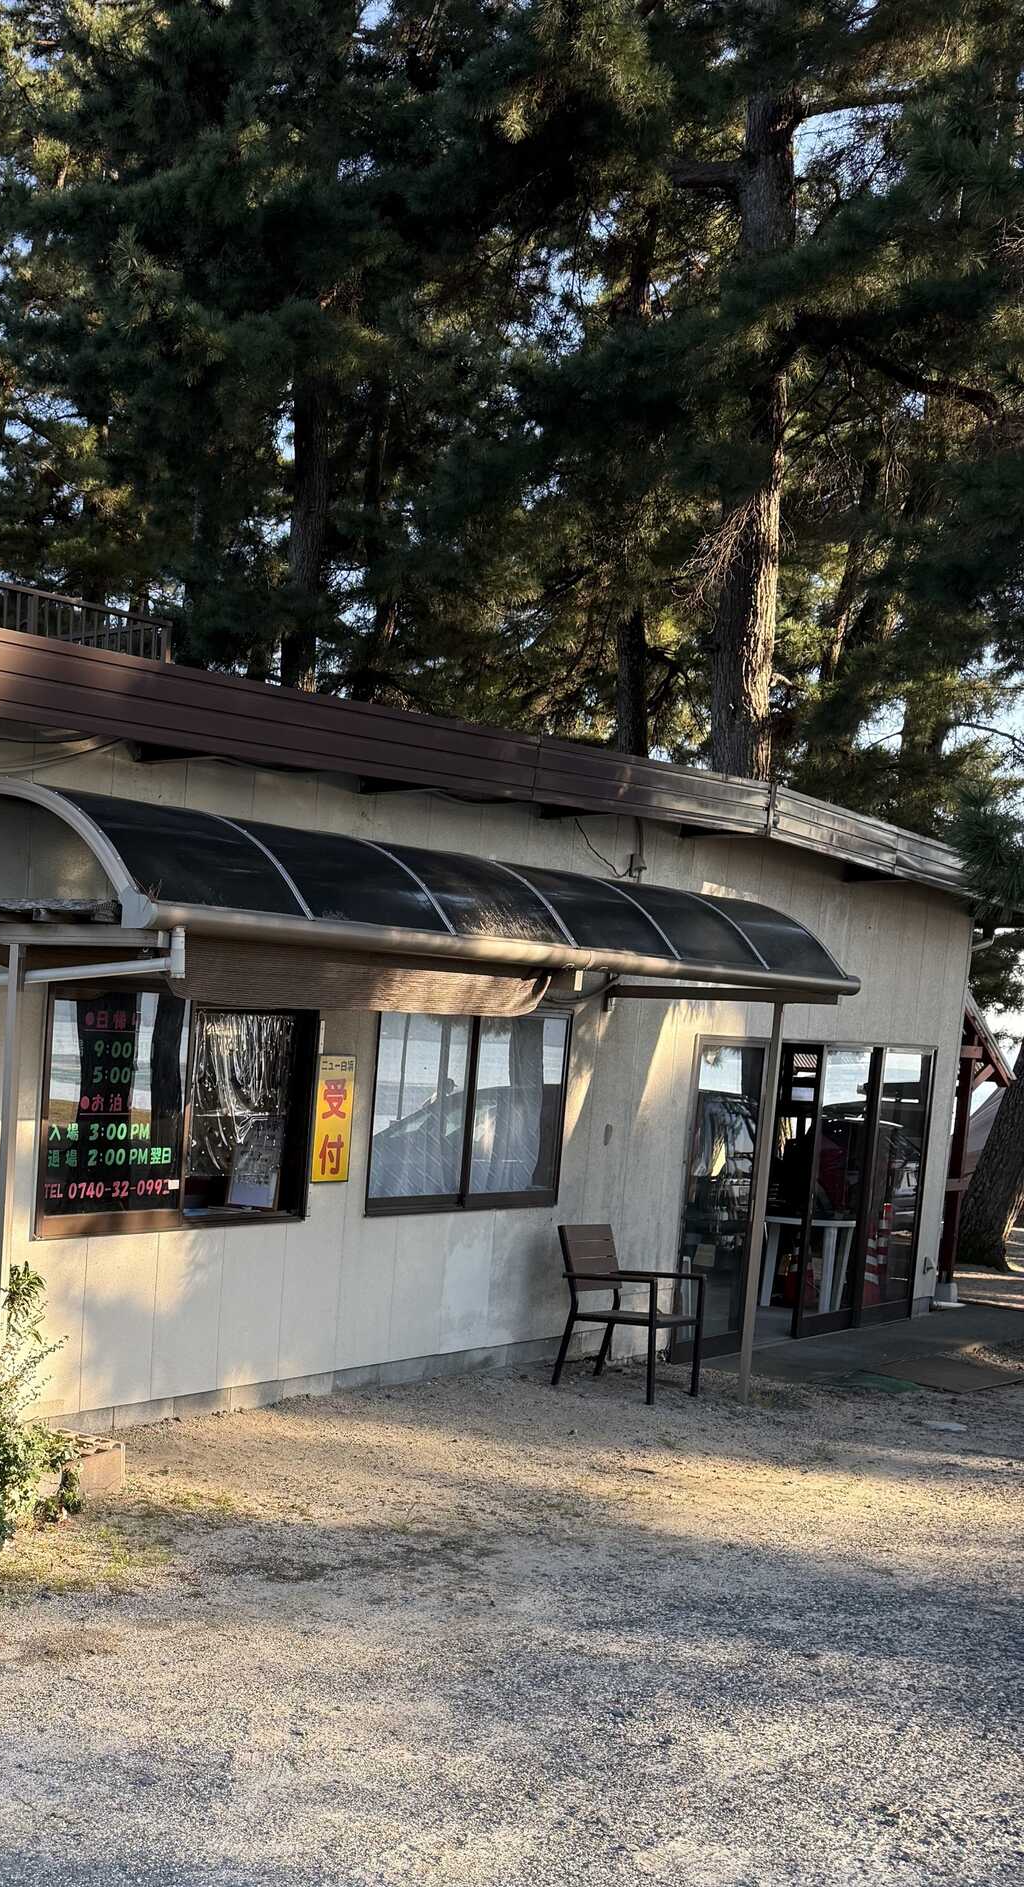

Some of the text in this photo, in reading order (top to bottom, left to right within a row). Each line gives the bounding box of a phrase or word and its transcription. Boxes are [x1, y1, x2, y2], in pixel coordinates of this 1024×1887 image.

[95, 1040, 132, 1058] 9:00
[92, 1066, 131, 1083] 5:00
[319, 1078, 347, 1175] 受付
[44, 1183, 63, 1199] TEL
